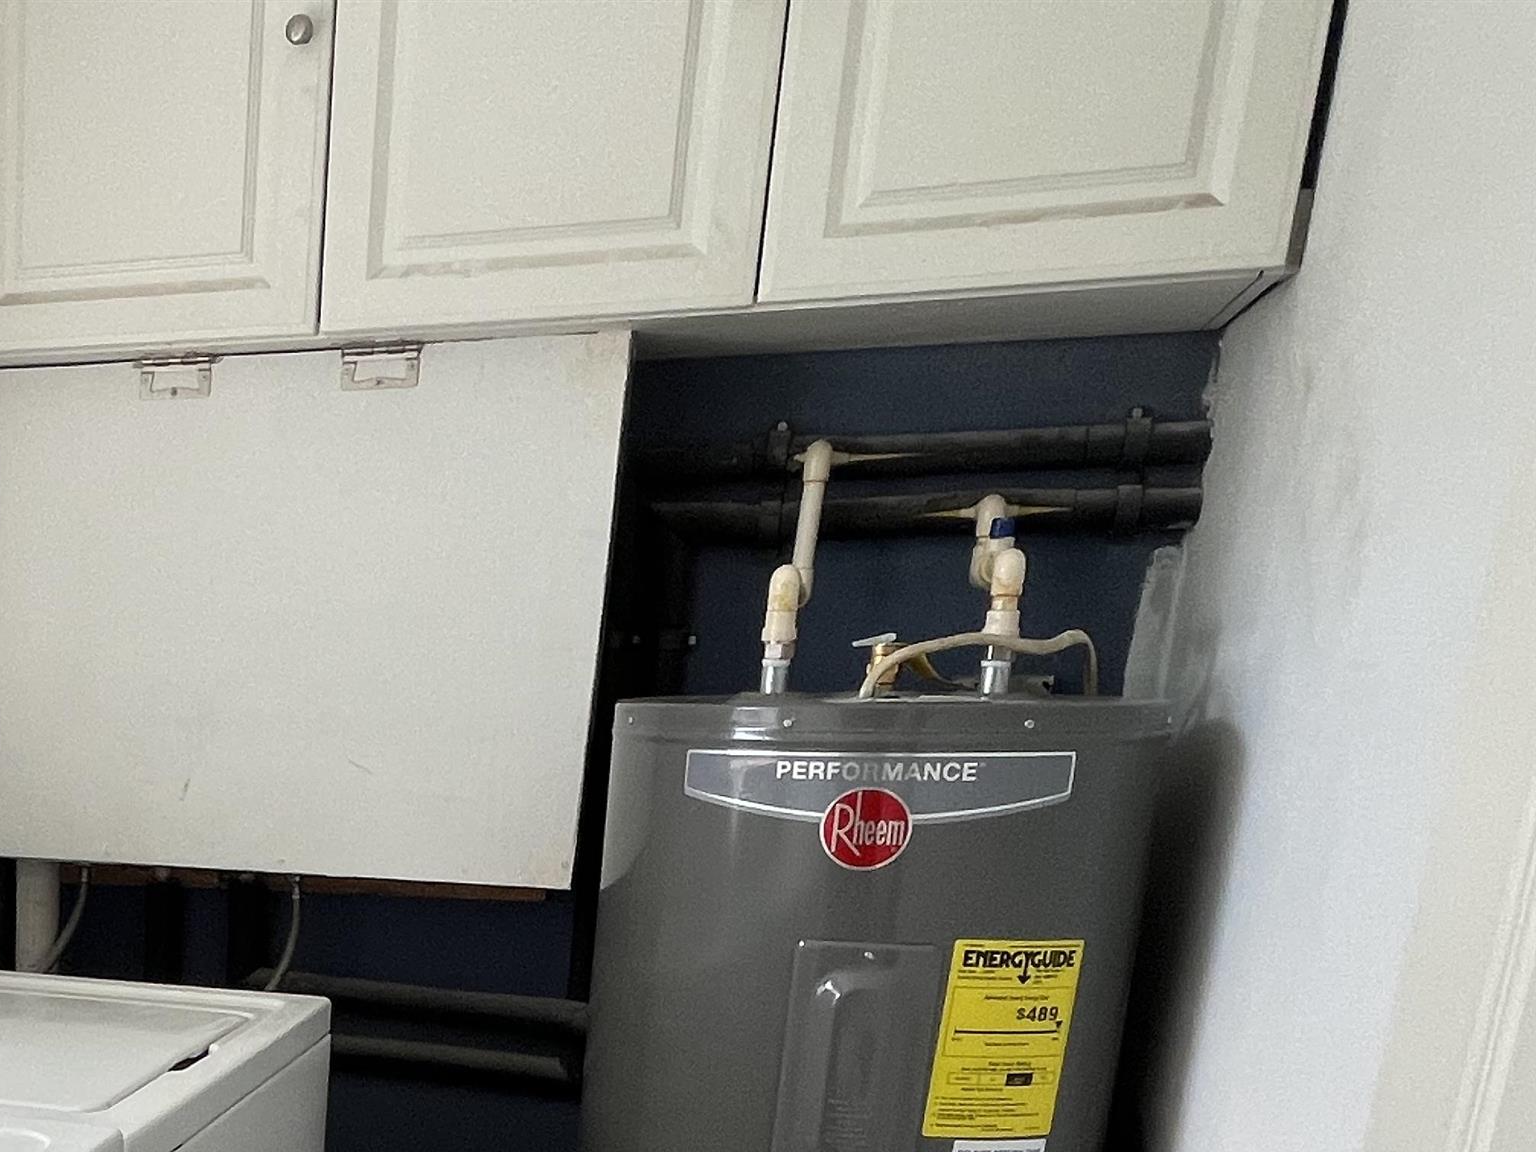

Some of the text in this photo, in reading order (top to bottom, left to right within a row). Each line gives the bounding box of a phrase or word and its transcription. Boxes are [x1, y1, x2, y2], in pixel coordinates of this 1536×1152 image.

[775, 760, 979, 783] PERFORMANCE
[829, 790, 906, 857] Rheem
[962, 949, 1077, 971] ENERGYGUIDE
[1016, 1006, 1059, 1022] $489
